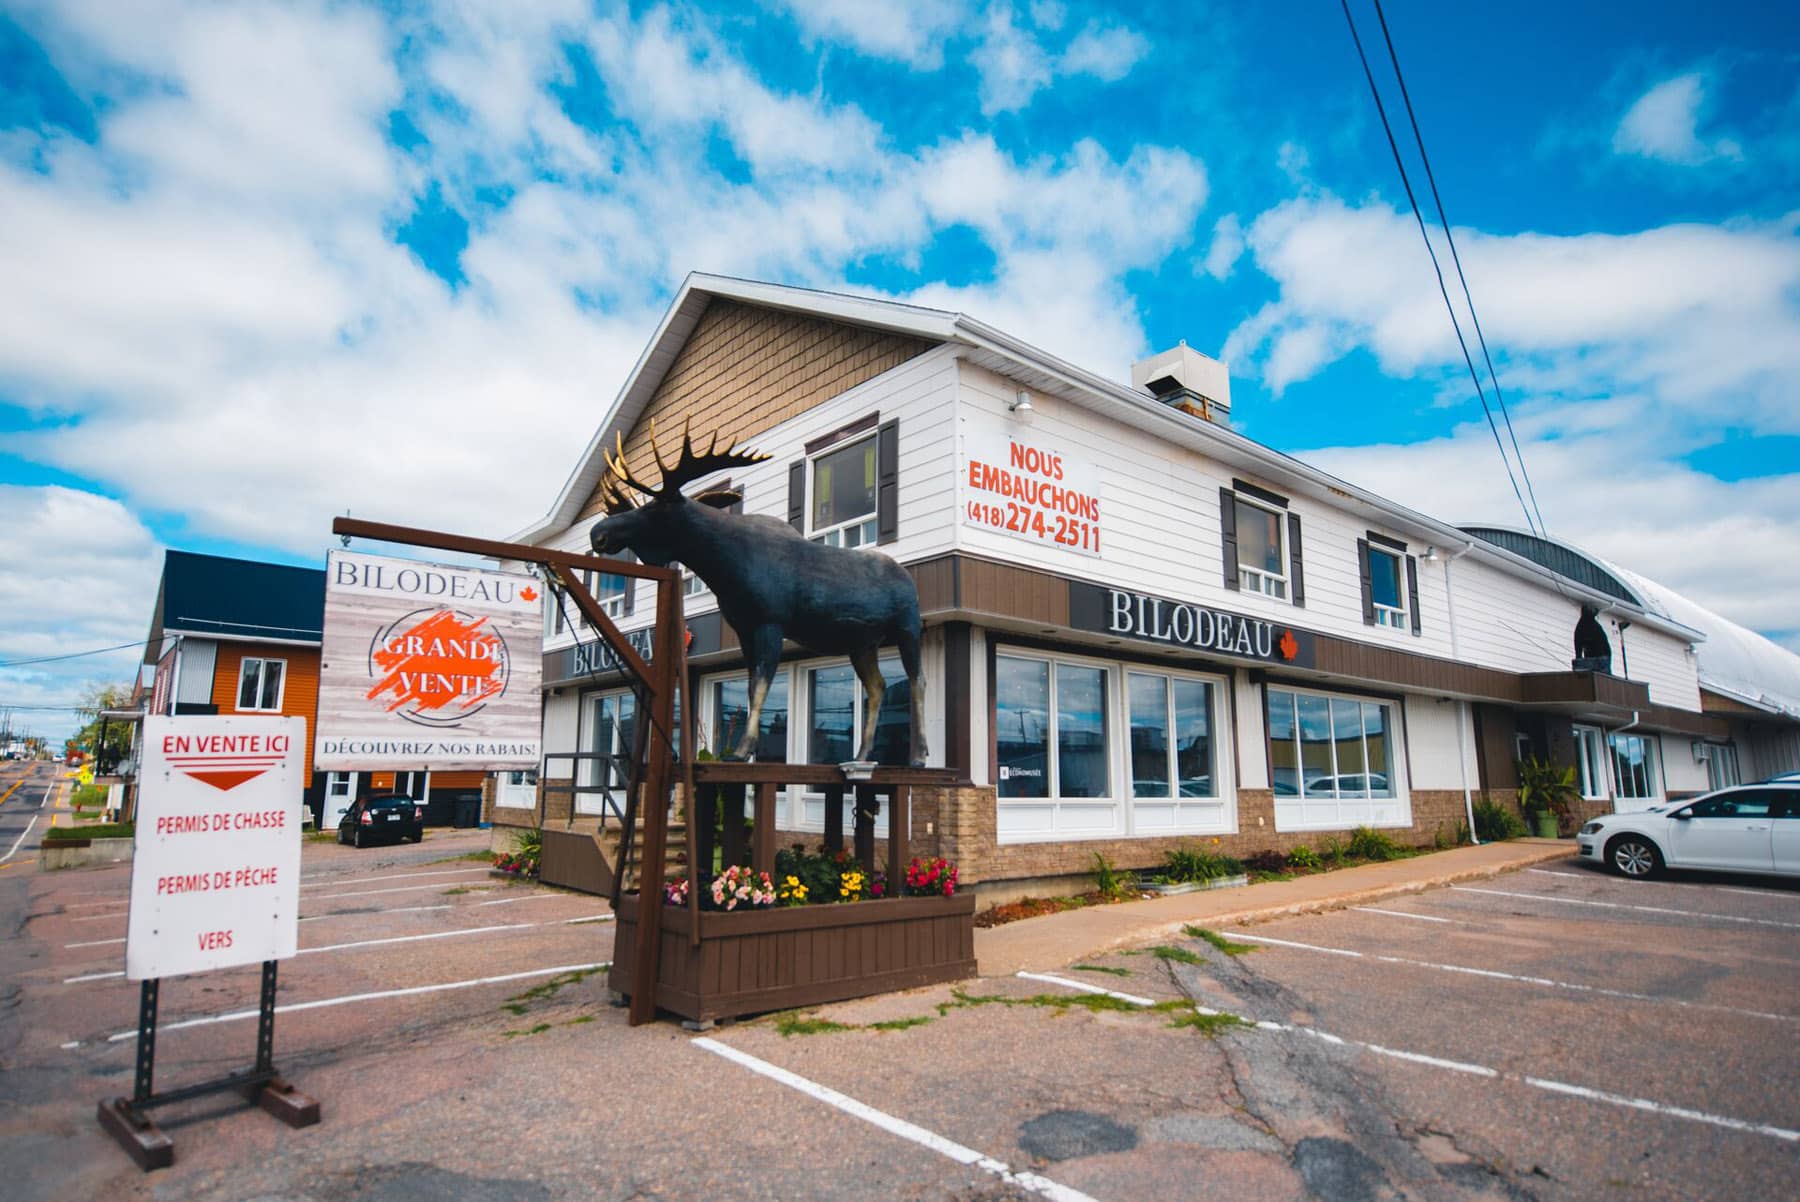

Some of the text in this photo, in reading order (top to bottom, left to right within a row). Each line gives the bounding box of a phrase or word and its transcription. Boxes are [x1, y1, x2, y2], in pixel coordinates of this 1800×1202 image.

[1010, 441, 1064, 480] NOUS
[969, 460, 1099, 522] EMBAUCHONS
[967, 500, 1100, 552] (418) 274-2511
[335, 560, 514, 604] BILODEAU
[1108, 589, 1273, 657] BILODEAU
[382, 635, 504, 663] GRANDE
[399, 671, 490, 695] VENTE
[163, 735, 289, 753] EN VENTE ICI
[323, 738, 536, 756] DÉCOUVREZ NOS RABAIS!
[157, 810, 286, 834] PERMIS DE CHASSE
[157, 866, 278, 895] PERMIS DE PÊCHE
[198, 930, 233, 951] VERS
